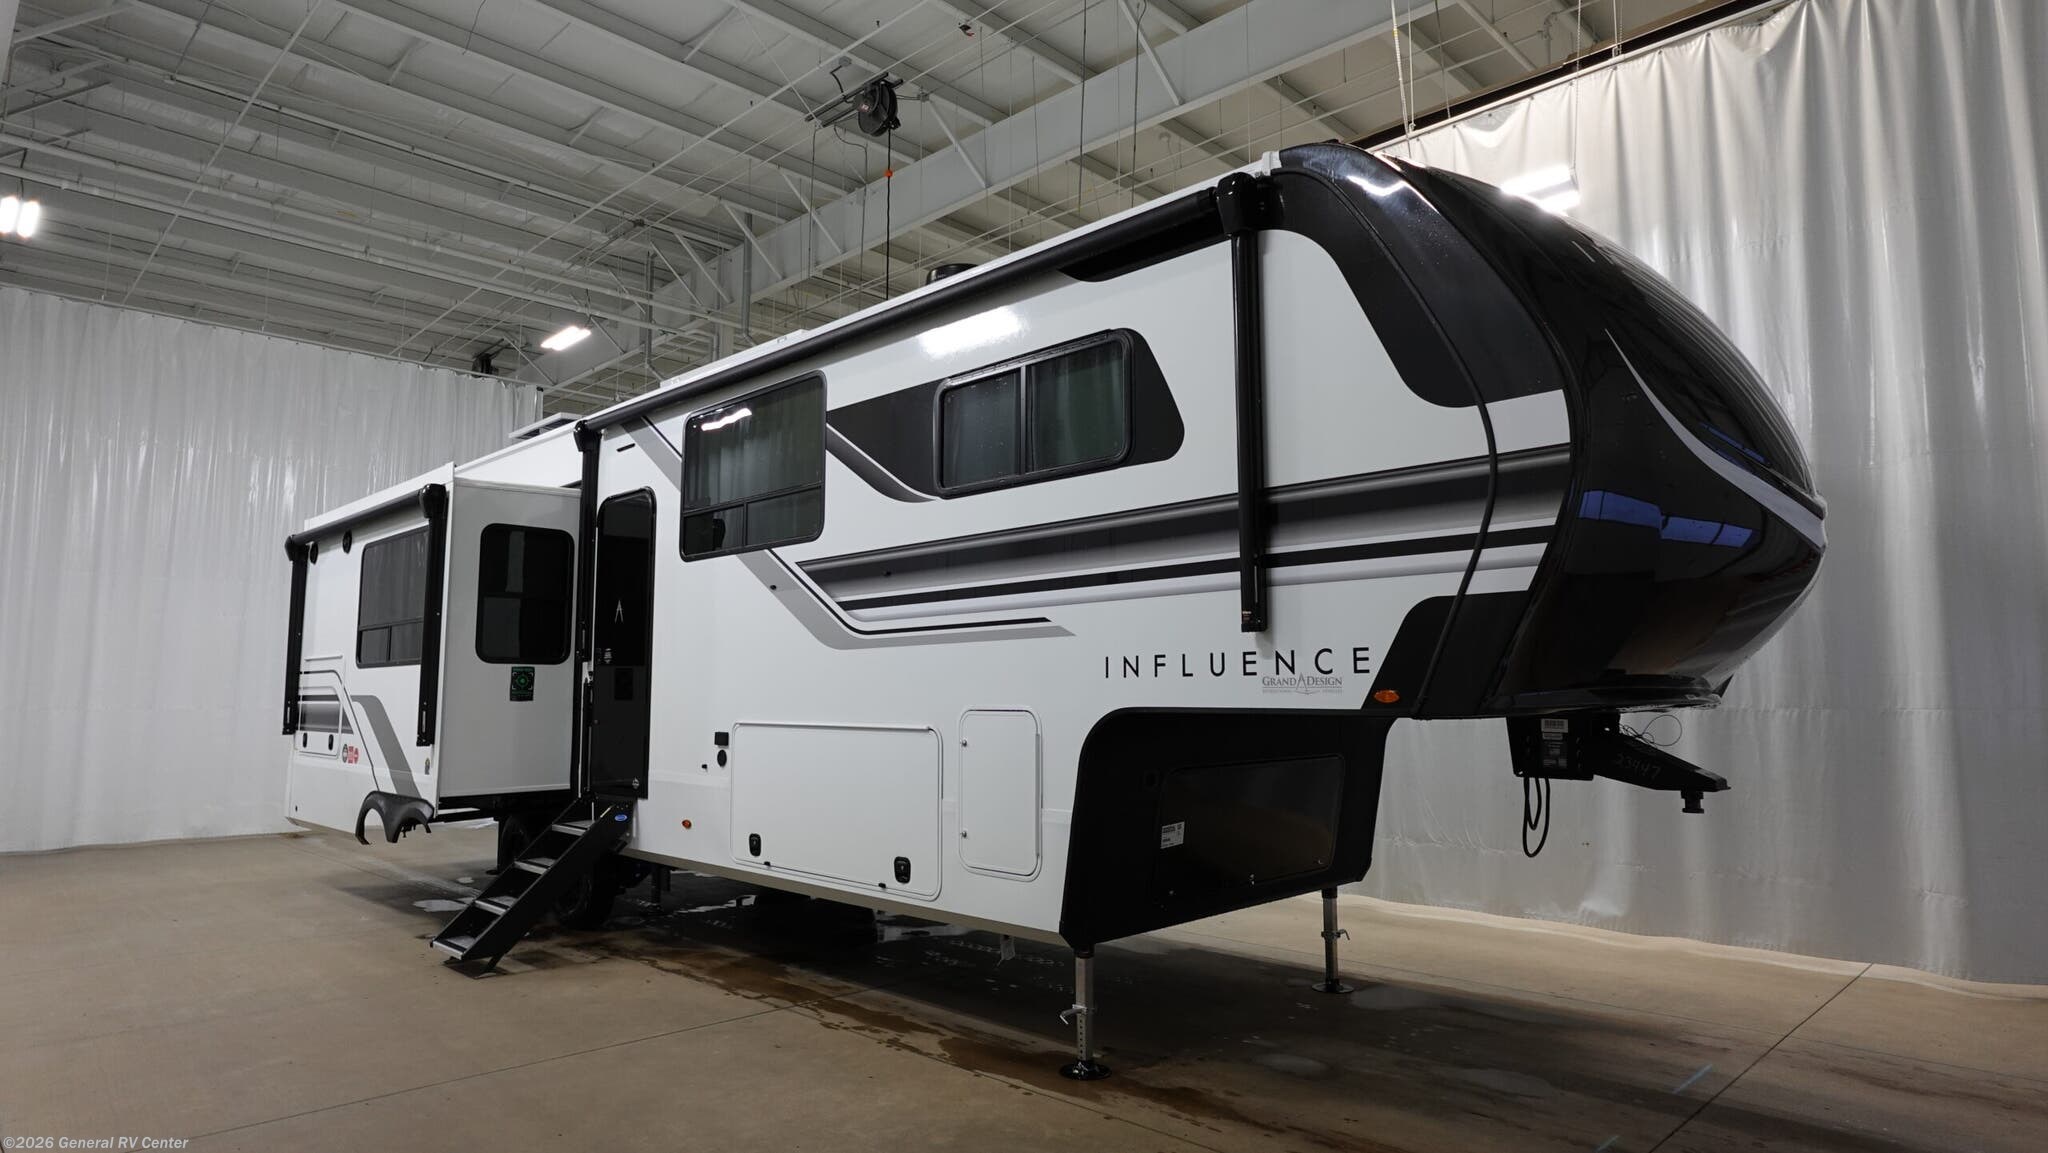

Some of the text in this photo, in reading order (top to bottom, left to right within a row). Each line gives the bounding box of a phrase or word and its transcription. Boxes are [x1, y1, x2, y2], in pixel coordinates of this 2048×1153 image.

[1105, 647, 1370, 678] INFLUENCE
[1262, 675, 1343, 687] GRAND DESIGN
